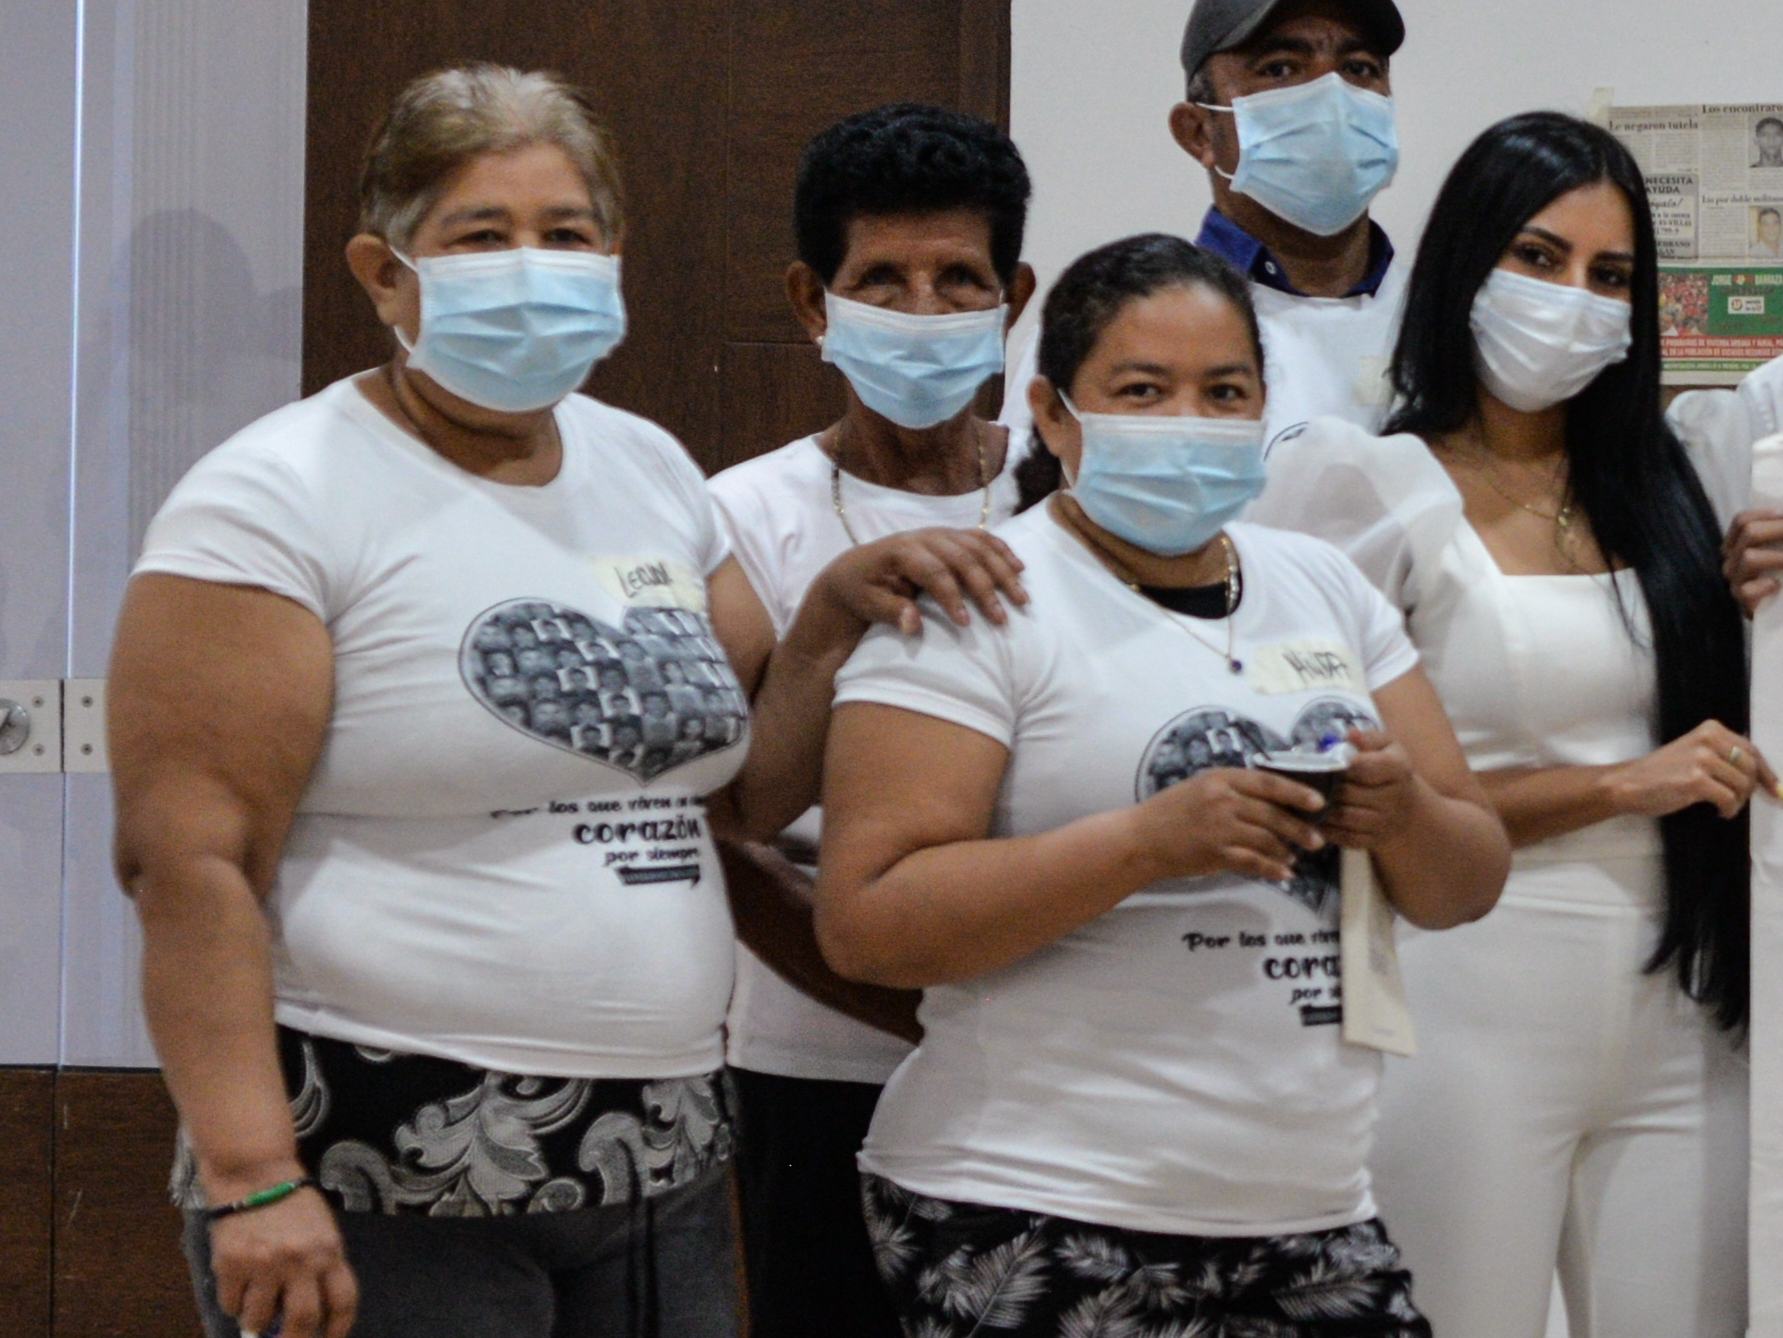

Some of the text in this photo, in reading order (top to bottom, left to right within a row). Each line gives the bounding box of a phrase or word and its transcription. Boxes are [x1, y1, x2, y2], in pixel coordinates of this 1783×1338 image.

[1702, 104, 1720, 114] Los
[1625, 121, 1666, 133] negaron
[1668, 119, 1698, 131] tutela
[1645, 176, 1693, 186] NECESITA
[1182, 931, 1267, 953] Por los
